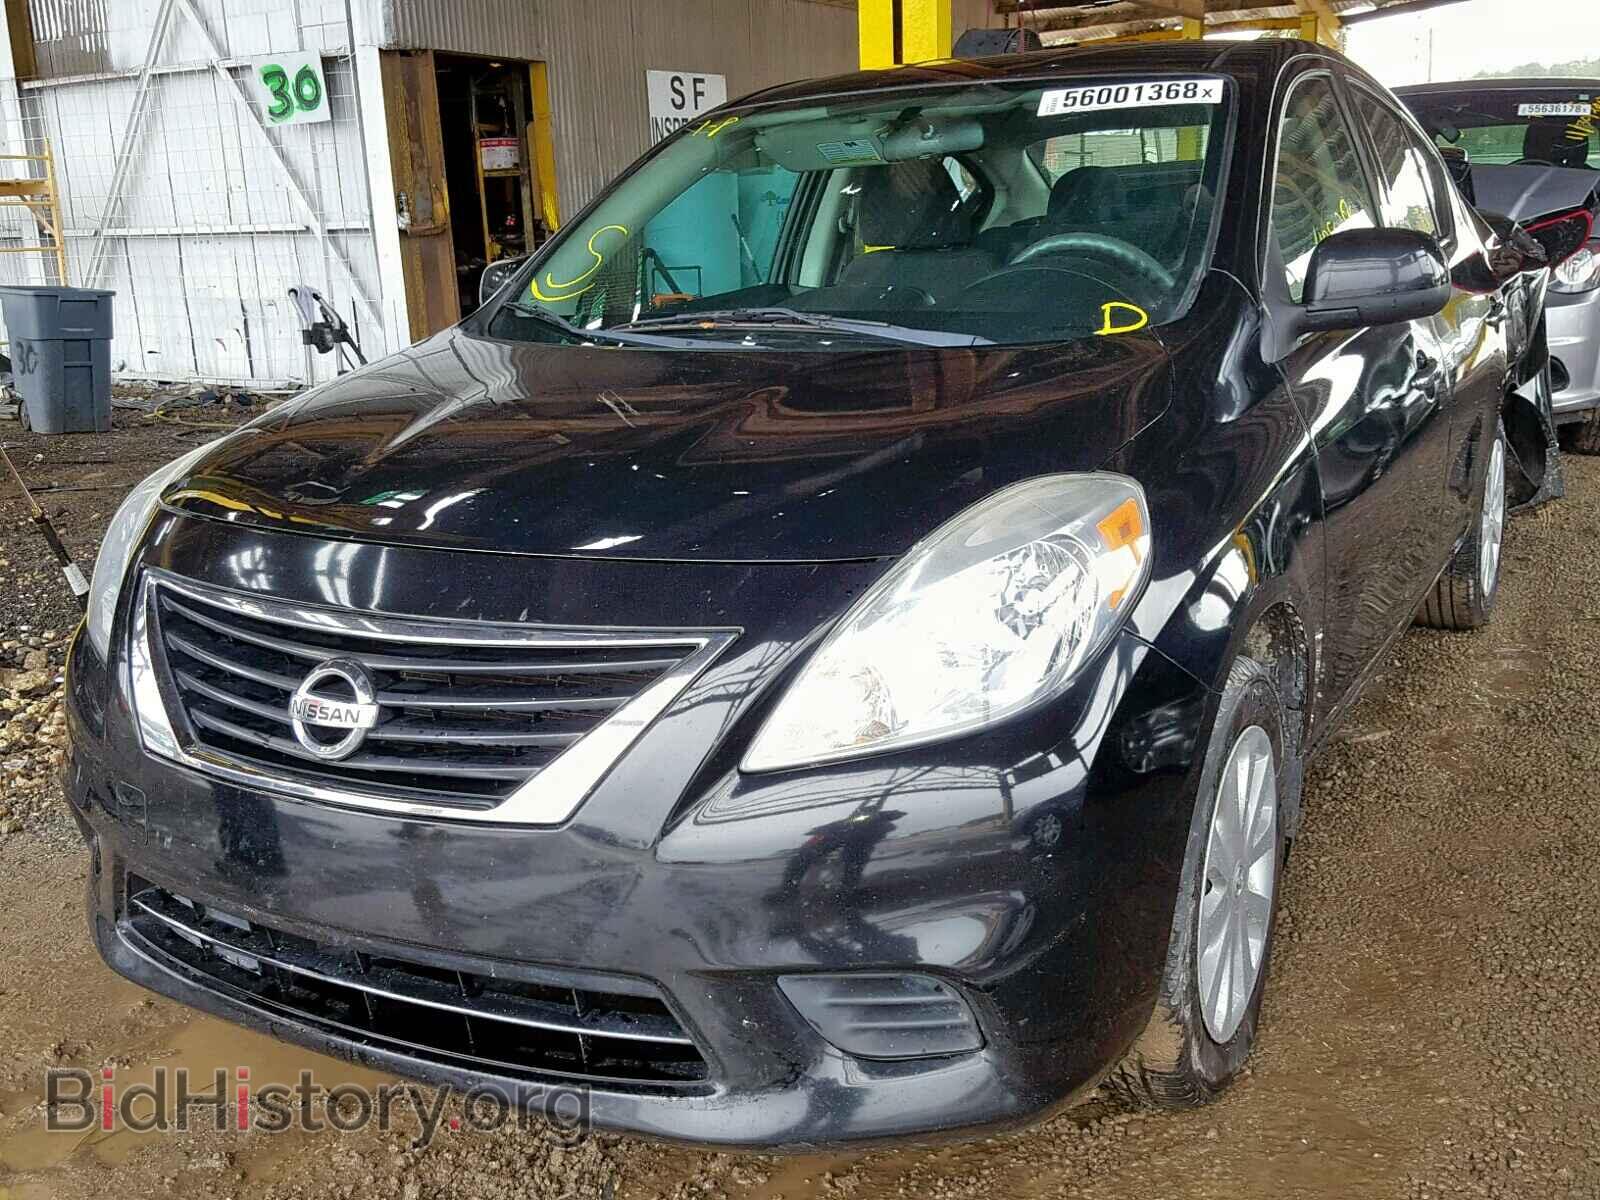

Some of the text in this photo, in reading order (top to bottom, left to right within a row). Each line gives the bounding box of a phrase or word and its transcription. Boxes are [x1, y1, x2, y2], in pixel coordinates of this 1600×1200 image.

[260, 64, 322, 122] 30
[1094, 302, 1148, 335] D
[291, 698, 361, 724] NISSAN
